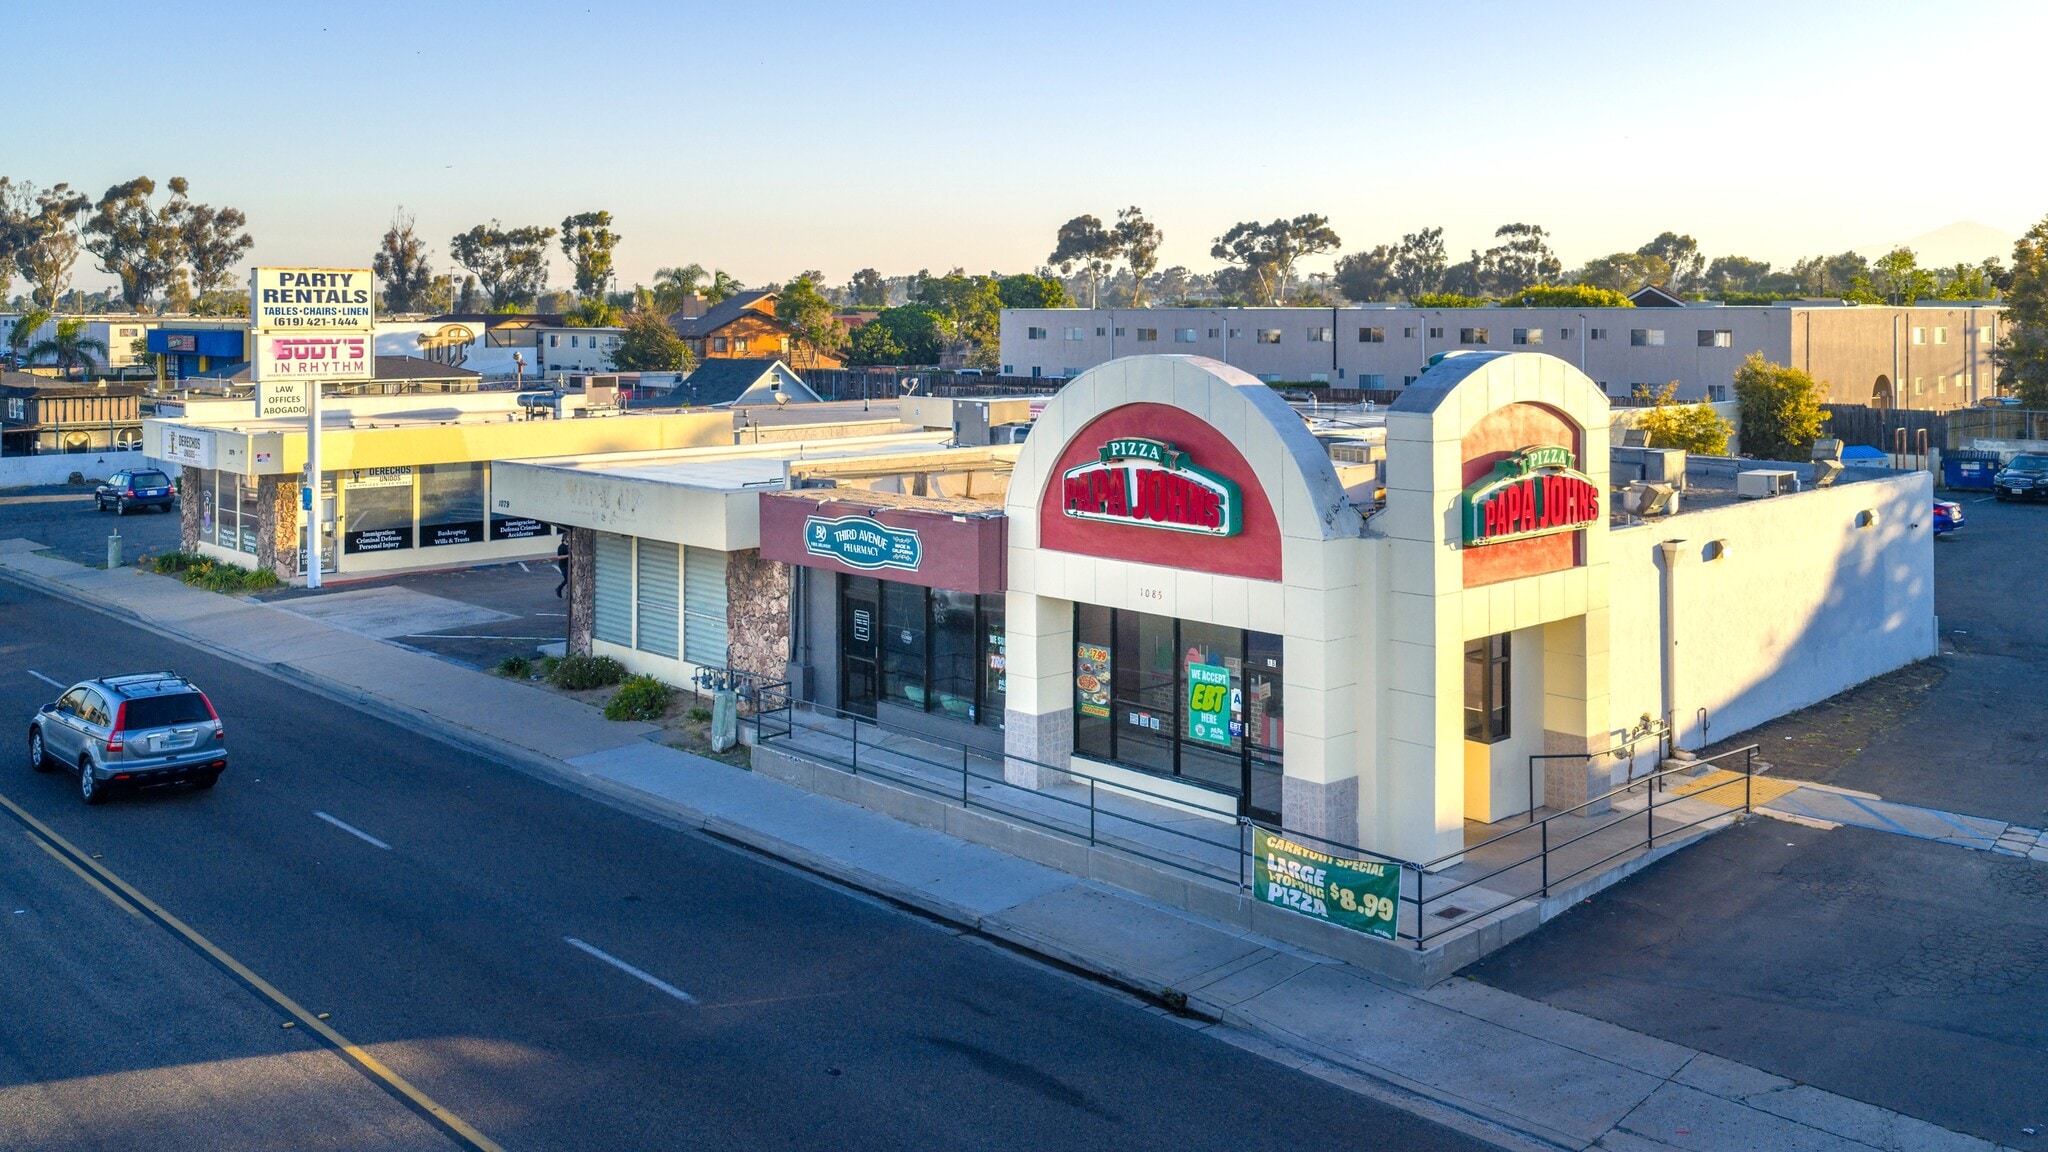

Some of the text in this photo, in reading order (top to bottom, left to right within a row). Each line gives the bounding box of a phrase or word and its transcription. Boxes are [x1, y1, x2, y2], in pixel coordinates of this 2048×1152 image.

[279, 272, 353, 287] PARTY
[263, 289, 368, 304] RENTALS
[264, 307, 369, 315] TABLES CHAIRS LINEN
[274, 317, 358, 326] (619) 421-1444
[275, 361, 364, 372] IN RHYTHM
[268, 396, 300, 404] OFFICES
[264, 406, 305, 415] ABOGADO
[179, 434, 201, 450] DERECHOS
[1110, 442, 1160, 460] PIZZA
[1530, 449, 1566, 465] PIZZA
[369, 465, 411, 476] DERECHOS
[1064, 467, 1129, 517] PAPA
[1484, 475, 1599, 538] PAPA JOHNS
[362, 530, 396, 538] Immigration
[437, 529, 467, 537] Bankruptcy
[834, 529, 888, 550] THIRD AVENUE
[382, 542, 399, 550] Injury
[843, 542, 880, 557] PHARMACY
[1140, 588, 1163, 599] 1085
[1078, 646, 1084, 658] 2
[1191, 669, 1226, 684] WE ACCEPT
[1191, 683, 1227, 713] EBT
[1234, 694, 1241, 704] A
[1201, 712, 1217, 724] HERE
[1230, 722, 1241, 730] EBT
[1266, 836, 1385, 877] CARRYOUT SPECIAL
[1267, 853, 1326, 887] LARGE
[1268, 871, 1325, 899] 1-TOPPING
[1268, 882, 1329, 918] PIZZA
[1330, 882, 1394, 922] $8.99
